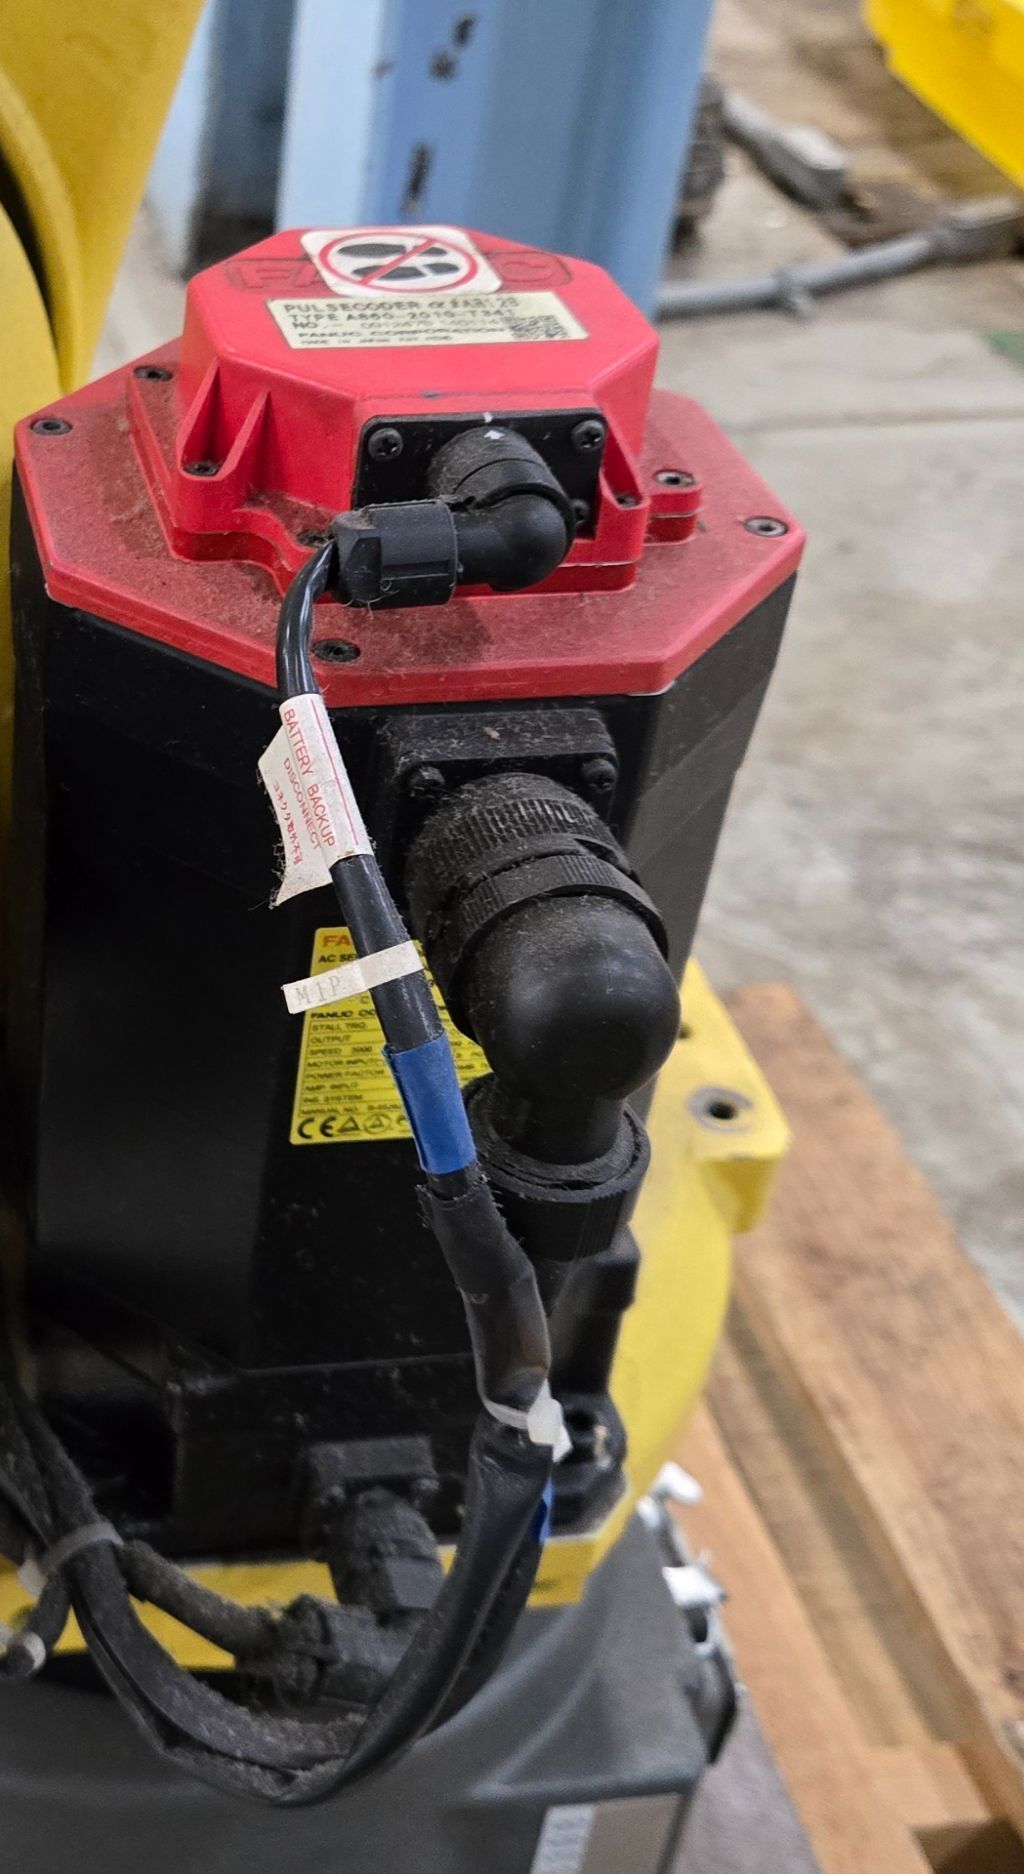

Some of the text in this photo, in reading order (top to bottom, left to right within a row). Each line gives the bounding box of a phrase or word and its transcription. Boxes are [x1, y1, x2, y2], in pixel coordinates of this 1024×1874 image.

[283, 301, 420, 313] PULSECODER
[288, 313, 340, 322] TYPE
[284, 708, 336, 847] BATTERY BACKUP
[284, 757, 322, 850] DISCONNECT
[318, 953, 337, 963] AC
